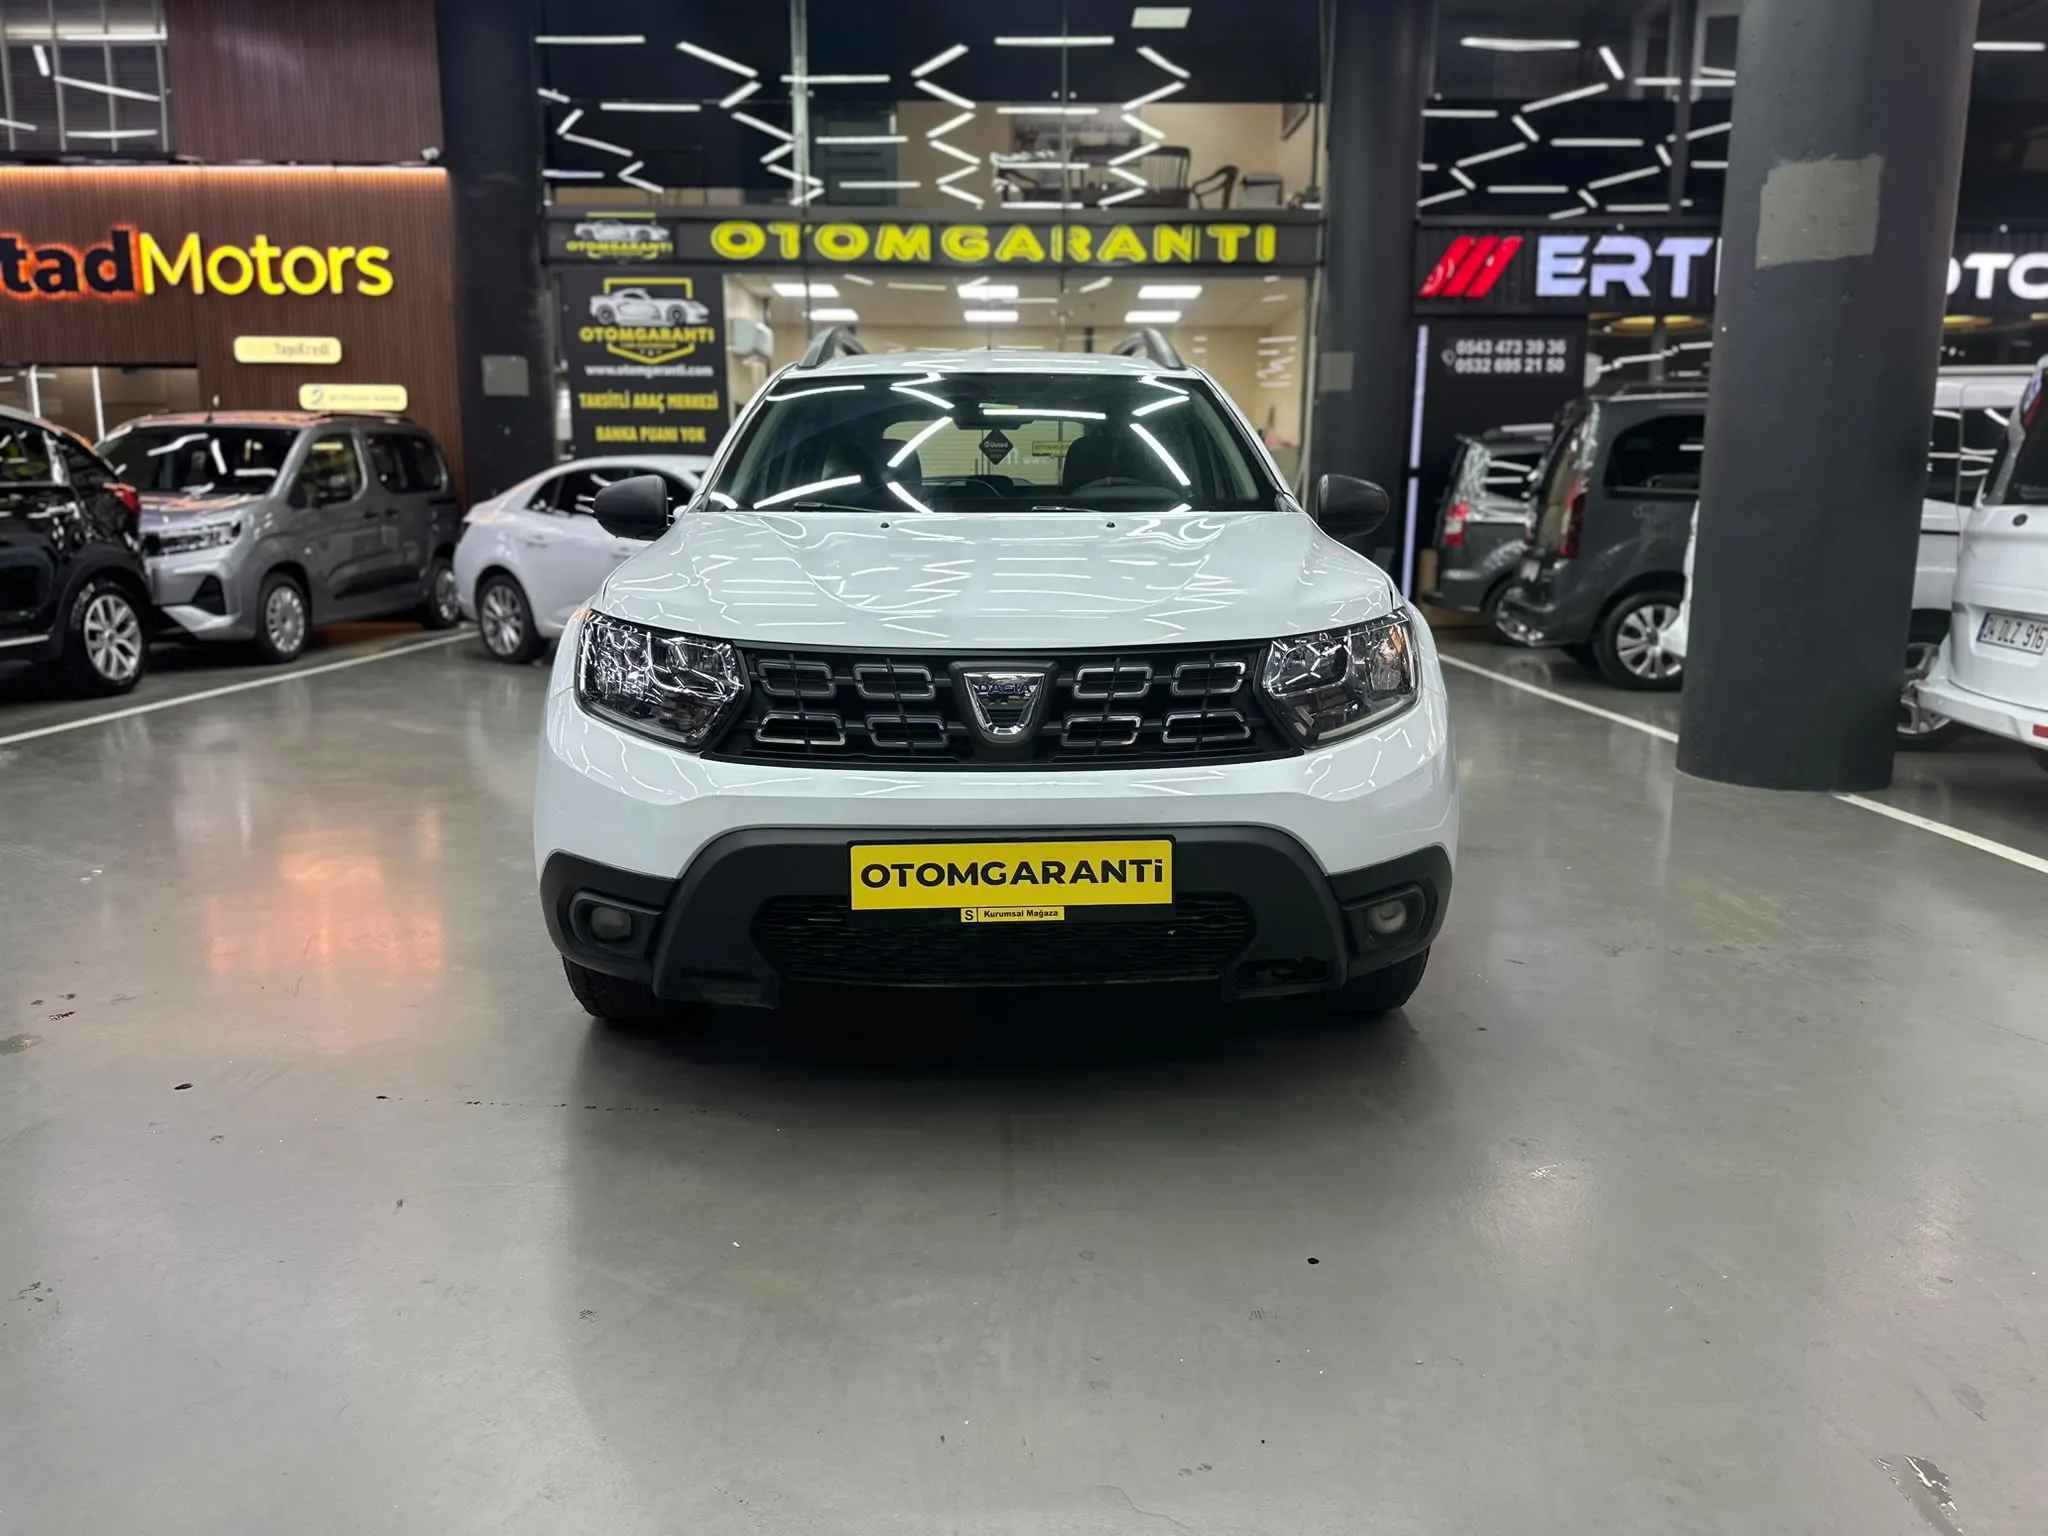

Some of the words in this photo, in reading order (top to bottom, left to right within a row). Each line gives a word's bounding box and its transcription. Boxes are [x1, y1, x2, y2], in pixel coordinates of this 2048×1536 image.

[1536, 235, 1722, 298] ERT
[585, 363, 714, 379] www.otomgaranti.com
[595, 425, 638, 442] BANKA
[983, 910, 1025, 918] Kurumsal
[1026, 908, 1059, 919] Mağaza
